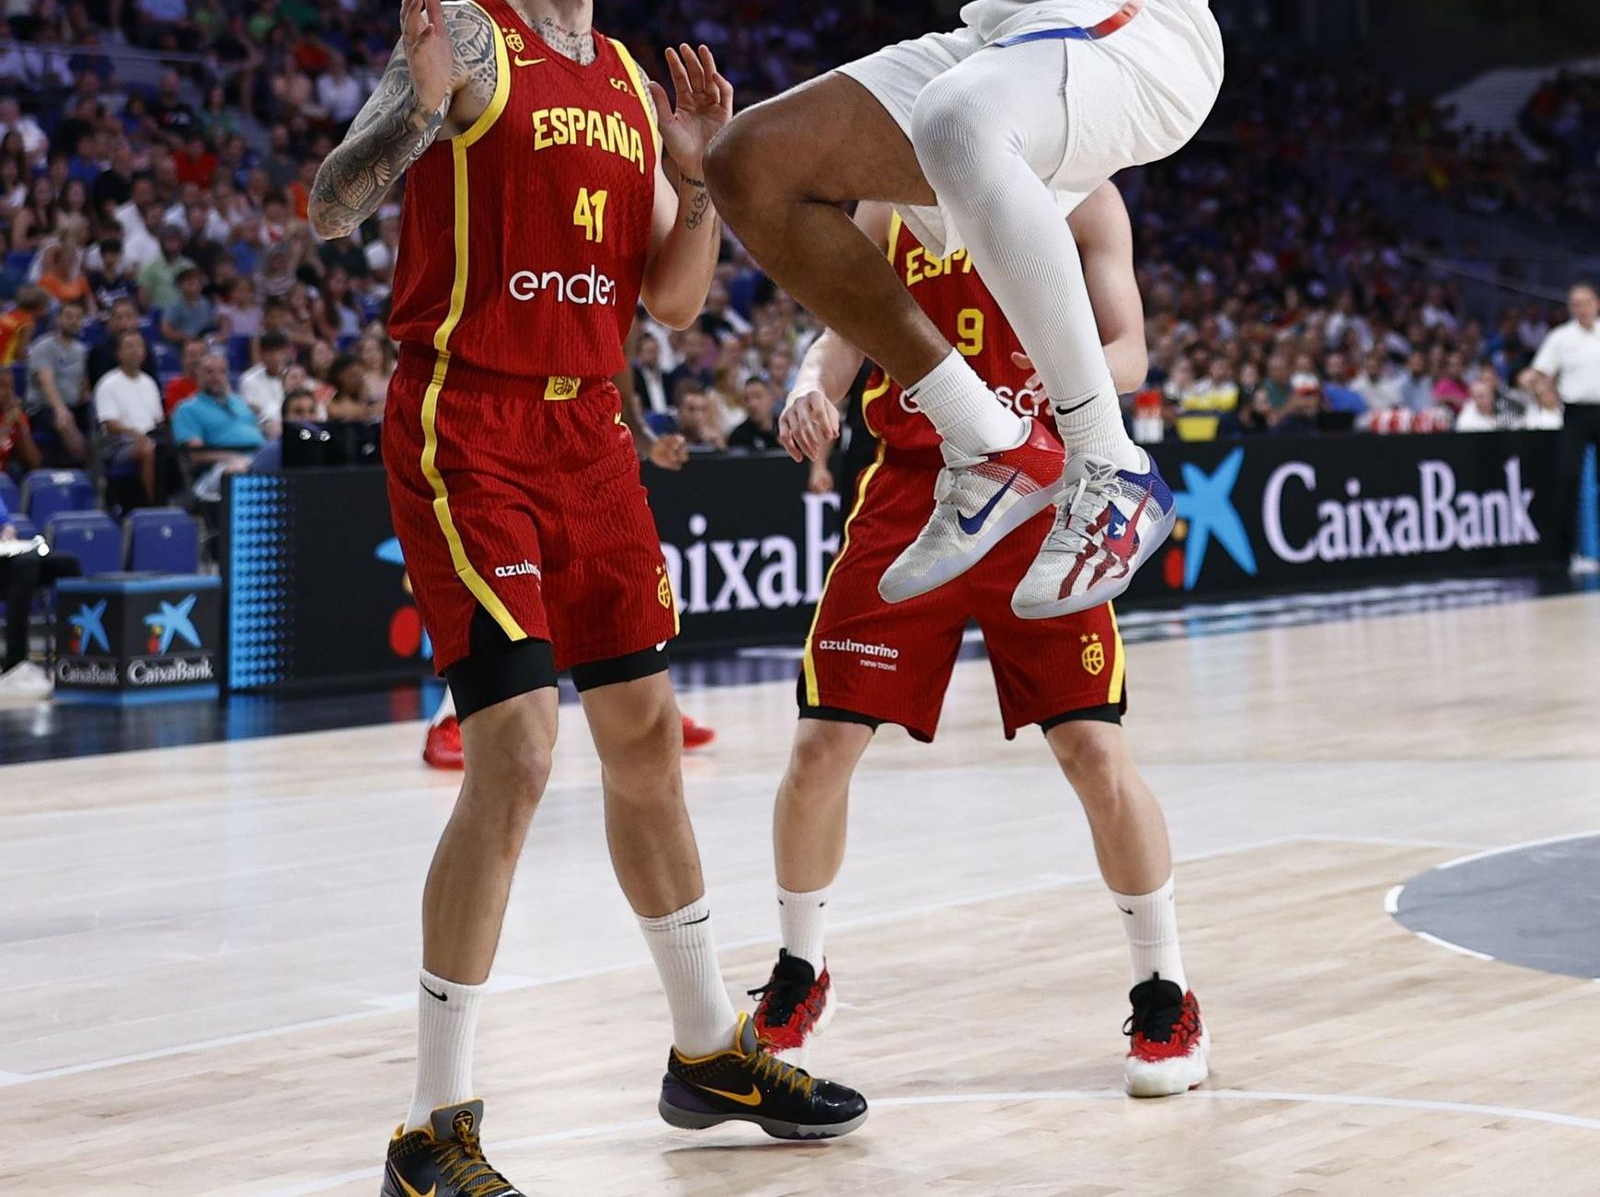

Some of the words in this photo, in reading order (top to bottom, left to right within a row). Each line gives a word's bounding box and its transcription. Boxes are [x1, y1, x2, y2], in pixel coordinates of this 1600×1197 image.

[532, 107, 645, 175] ESPAÑA
[573, 187, 608, 243] 41
[508, 264, 617, 307] ende
[906, 246, 974, 287] ESP
[956, 308, 985, 356] 9
[1262, 455, 1541, 564] CaixaBank
[127, 656, 214, 684] CaixaBank
[818, 638, 899, 658] azulmarino
